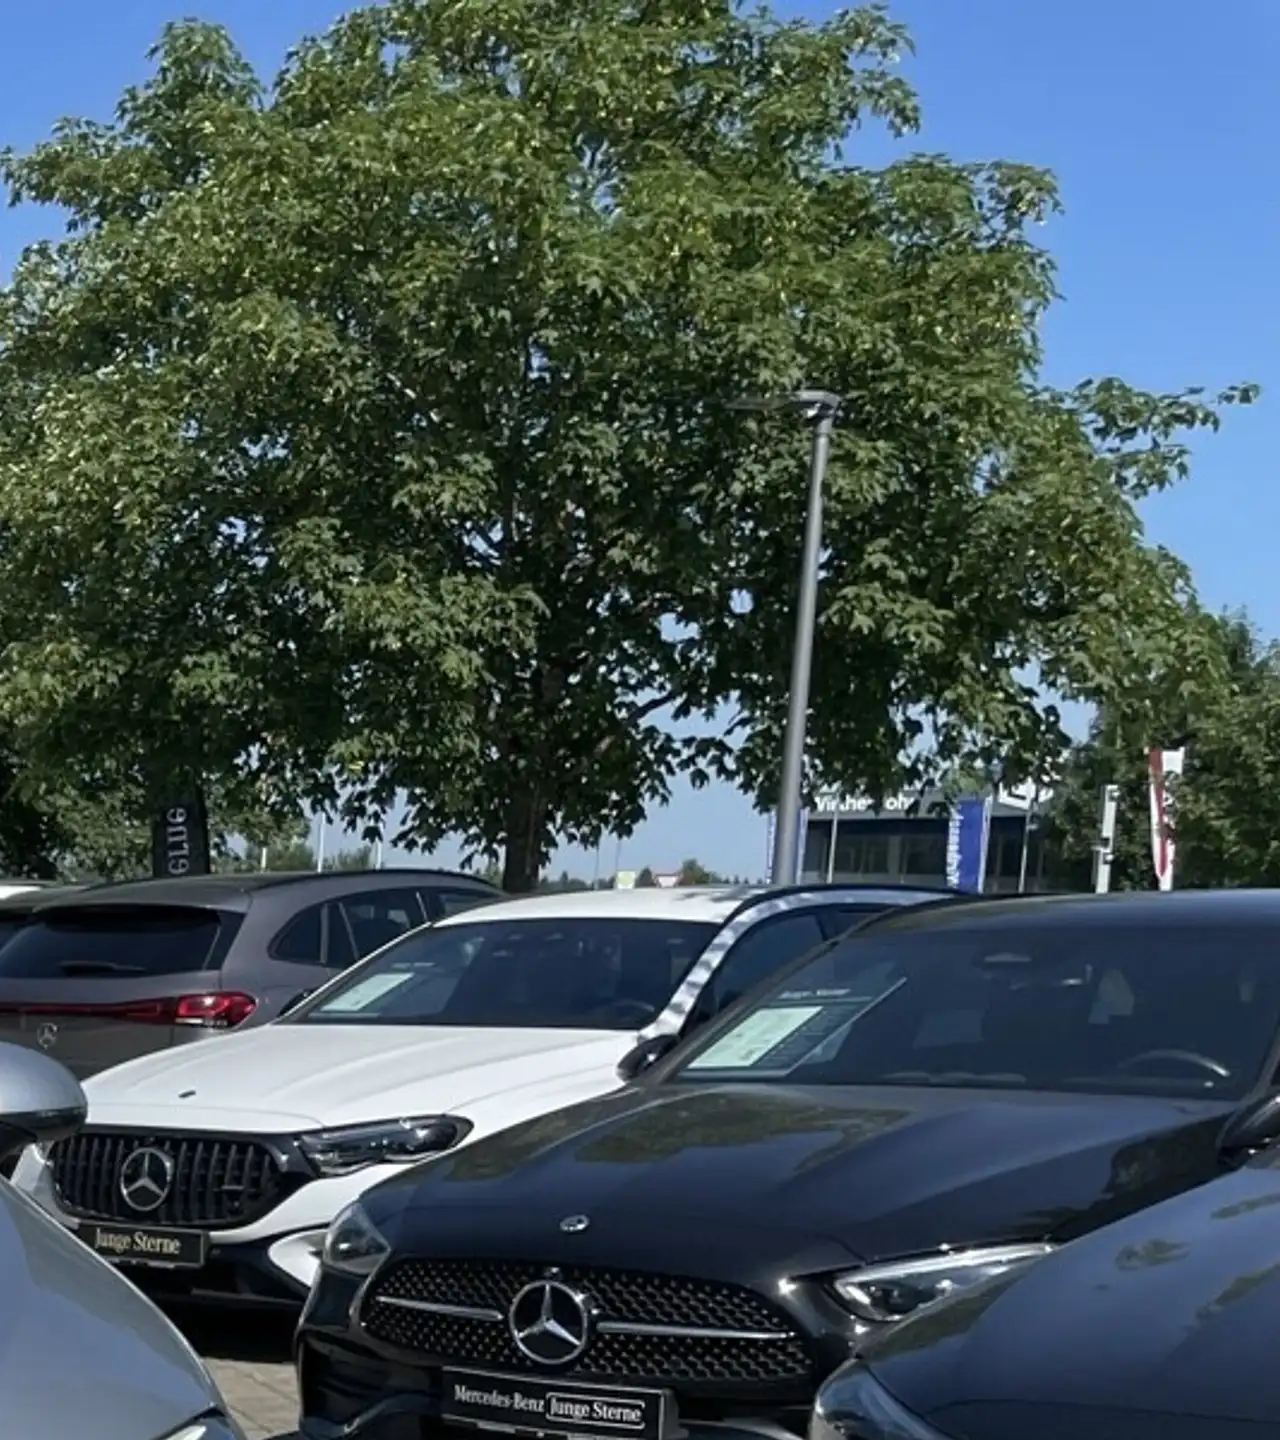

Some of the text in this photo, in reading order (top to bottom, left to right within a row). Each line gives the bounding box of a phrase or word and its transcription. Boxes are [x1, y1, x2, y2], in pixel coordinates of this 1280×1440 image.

[94, 1226, 181, 1255] Junge Sterne
[454, 1384, 643, 1423] Mercedes-Benz Junge Sterne
